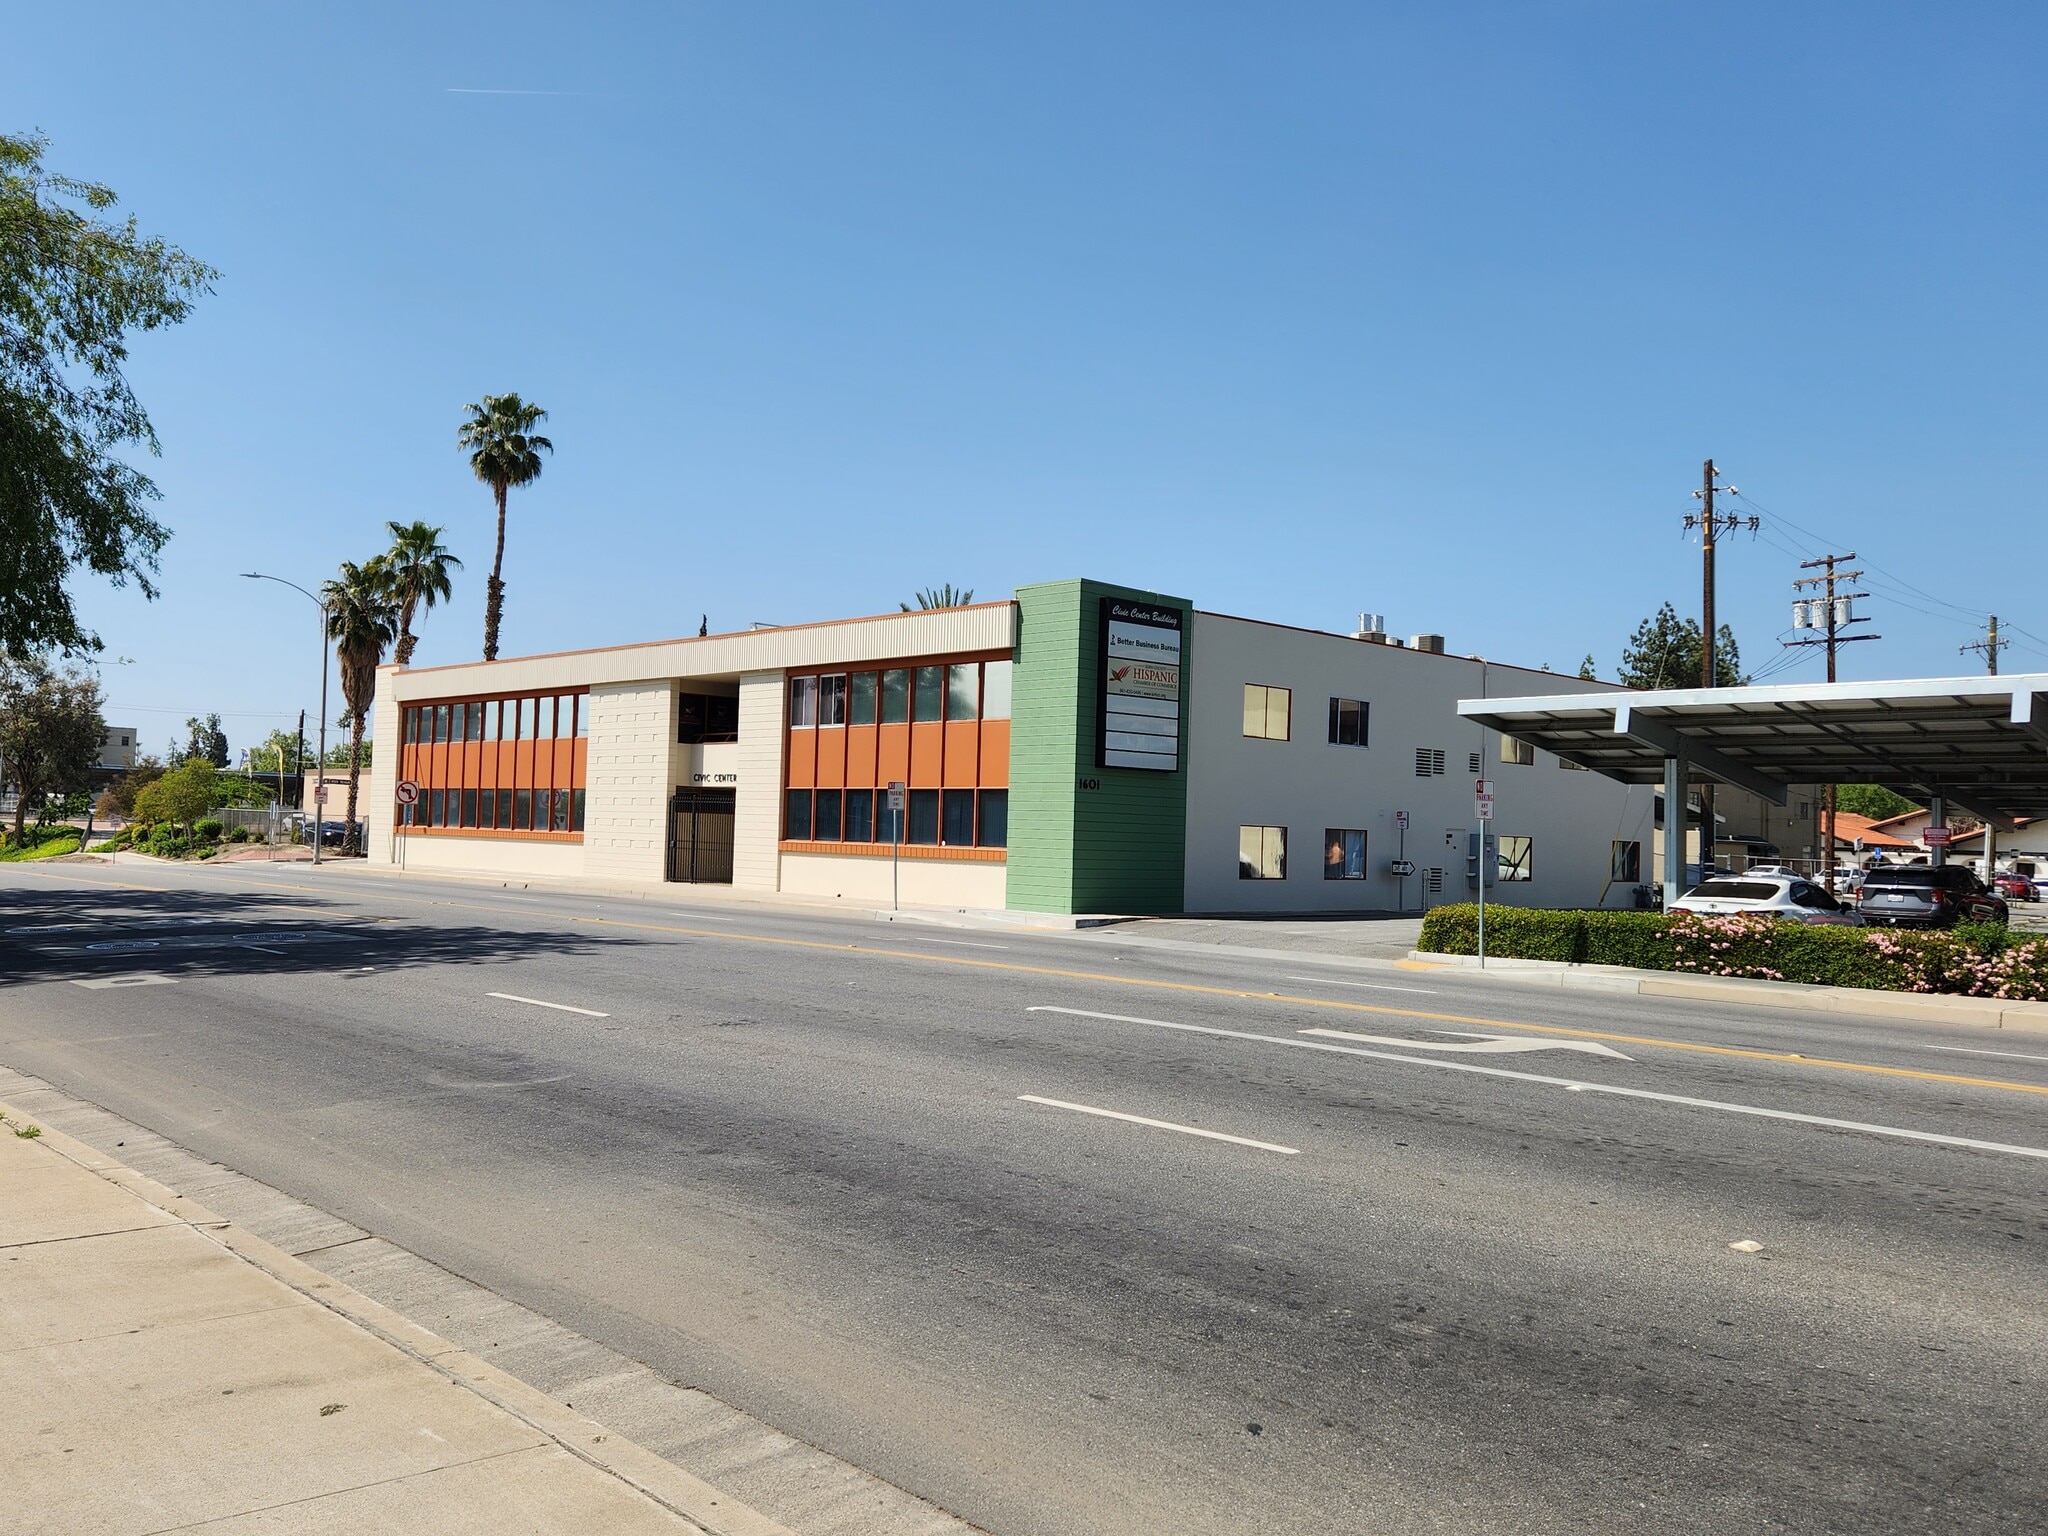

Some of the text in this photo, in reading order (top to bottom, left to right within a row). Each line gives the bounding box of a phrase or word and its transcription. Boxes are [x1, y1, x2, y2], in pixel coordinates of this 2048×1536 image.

[1112, 605, 1177, 627] Civic Center Building
[1117, 637, 1179, 652] Better Business Bureau
[1133, 667, 1178, 683] HISPANIC
[693, 773, 737, 782] CIVIC CENTER
[1079, 778, 1100, 790] 1601
